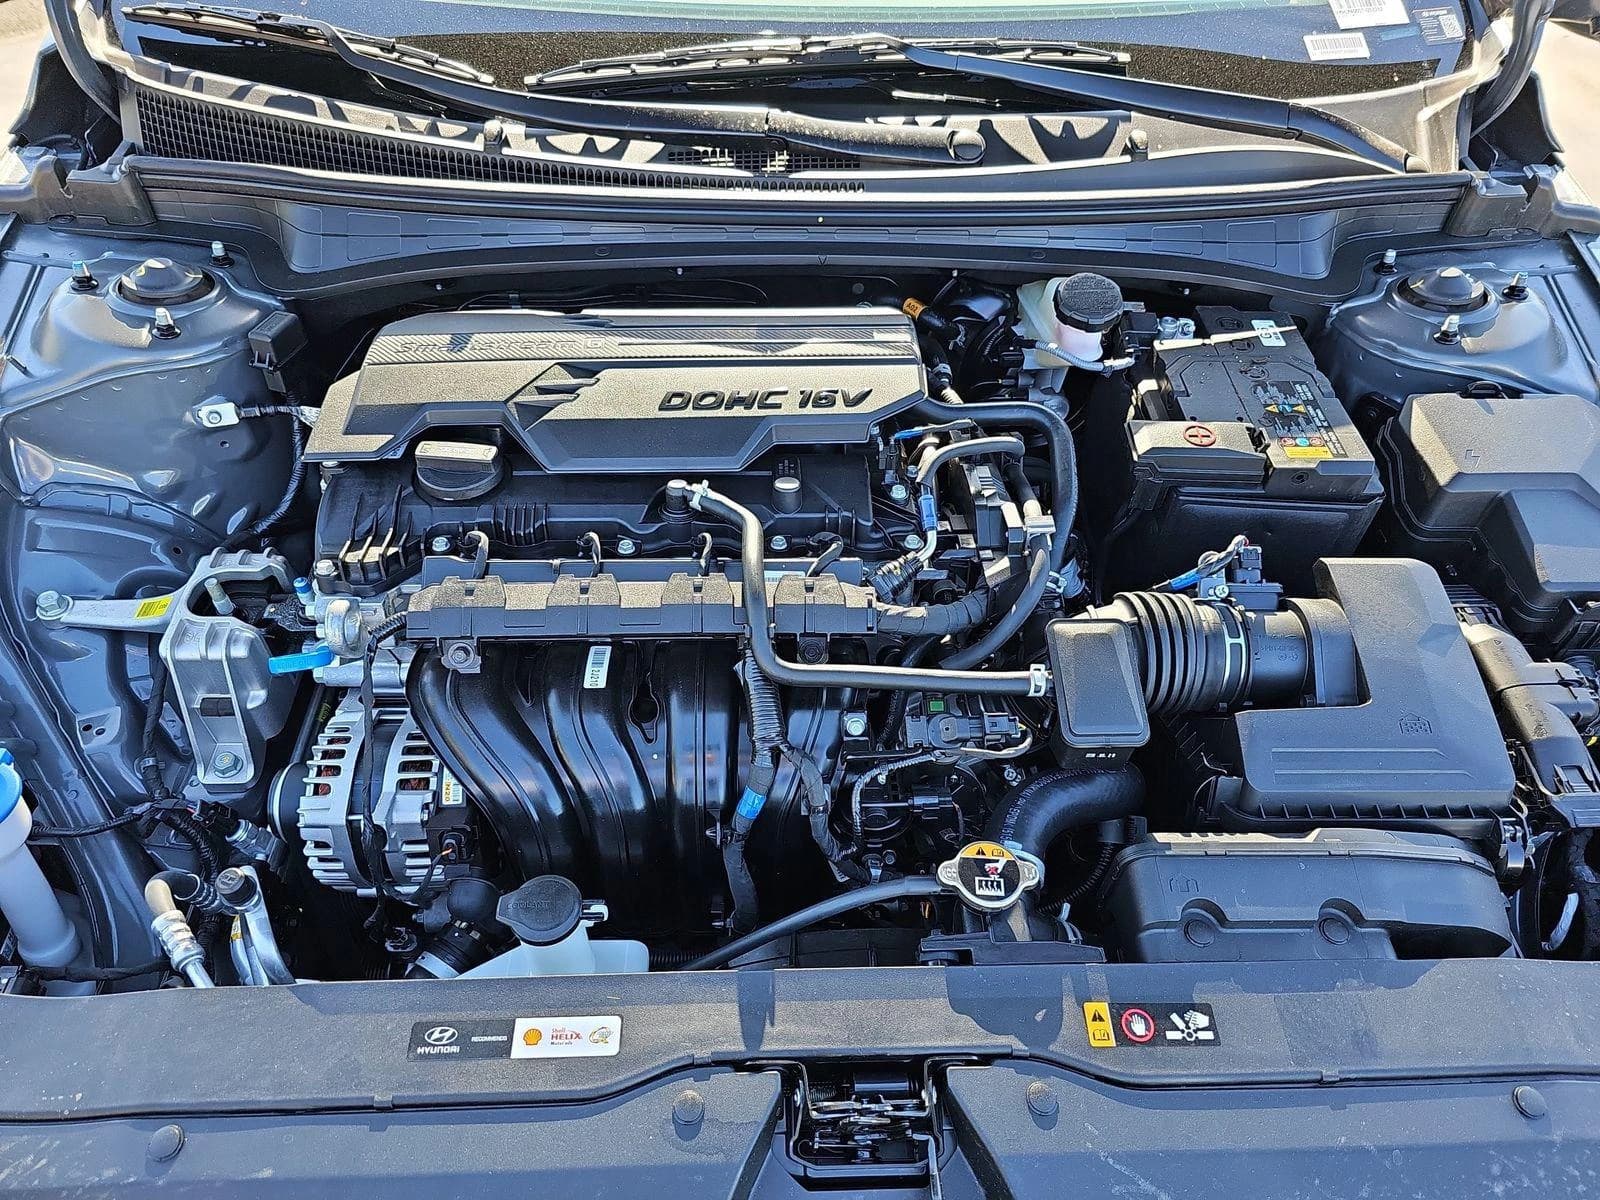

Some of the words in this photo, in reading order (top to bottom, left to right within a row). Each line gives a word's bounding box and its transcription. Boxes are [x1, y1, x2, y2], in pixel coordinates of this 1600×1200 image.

[658, 388, 788, 411] DOHC
[798, 387, 873, 408] 16V
[506, 900, 550, 910] COOLANT
[551, 1032, 581, 1040] HELIX
[417, 1046, 460, 1055] HYUNDAI
